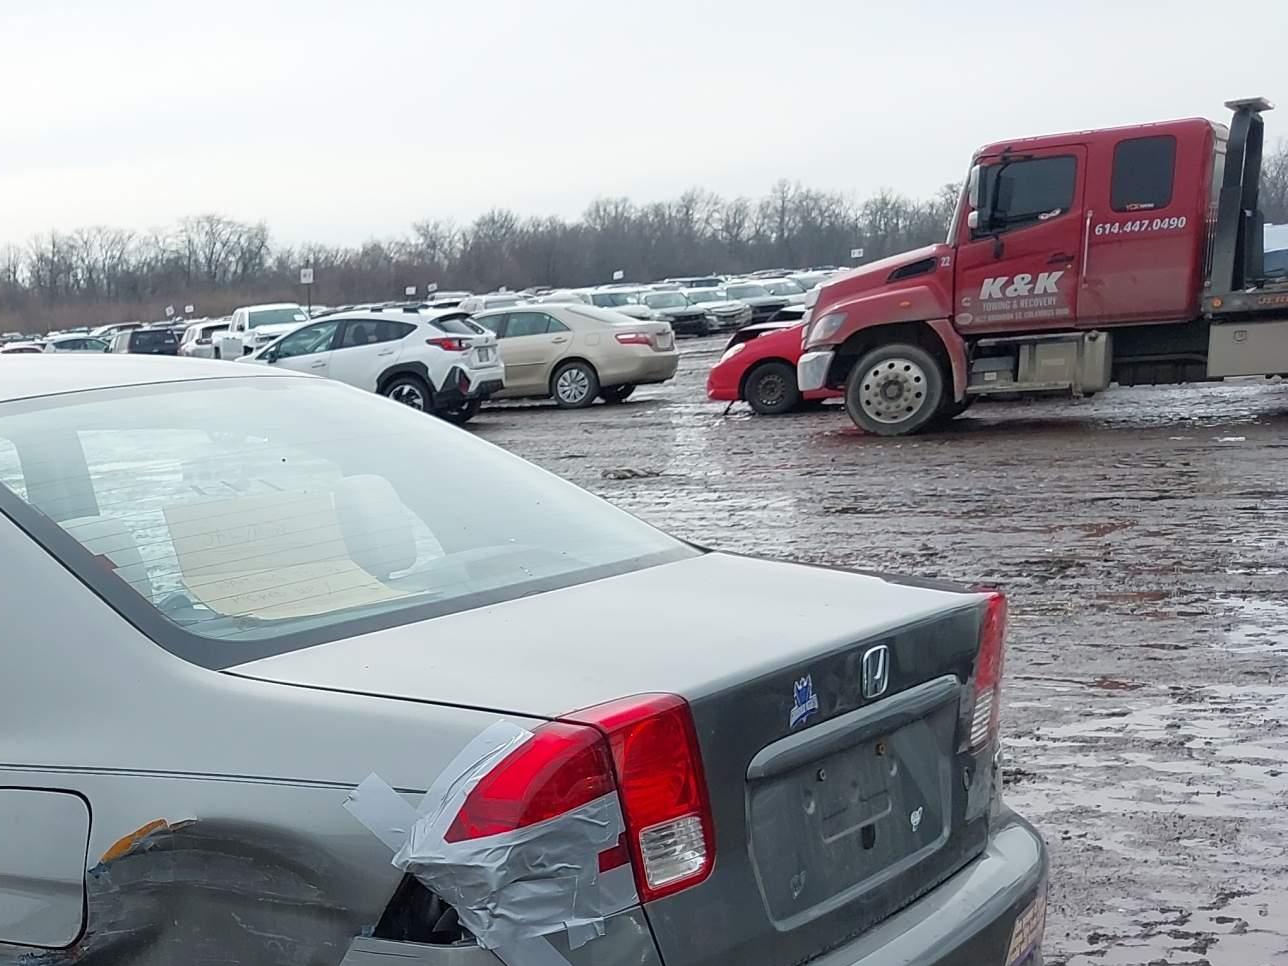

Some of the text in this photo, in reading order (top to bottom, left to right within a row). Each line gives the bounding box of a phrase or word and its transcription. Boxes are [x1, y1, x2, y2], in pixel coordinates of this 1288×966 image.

[1095, 216, 1187, 236] 614.447.0490
[940, 256, 951, 267] 22
[979, 271, 1065, 300] K&K
[983, 300, 1011, 311] TOWING
[1021, 296, 1057, 308] RECOVERY
